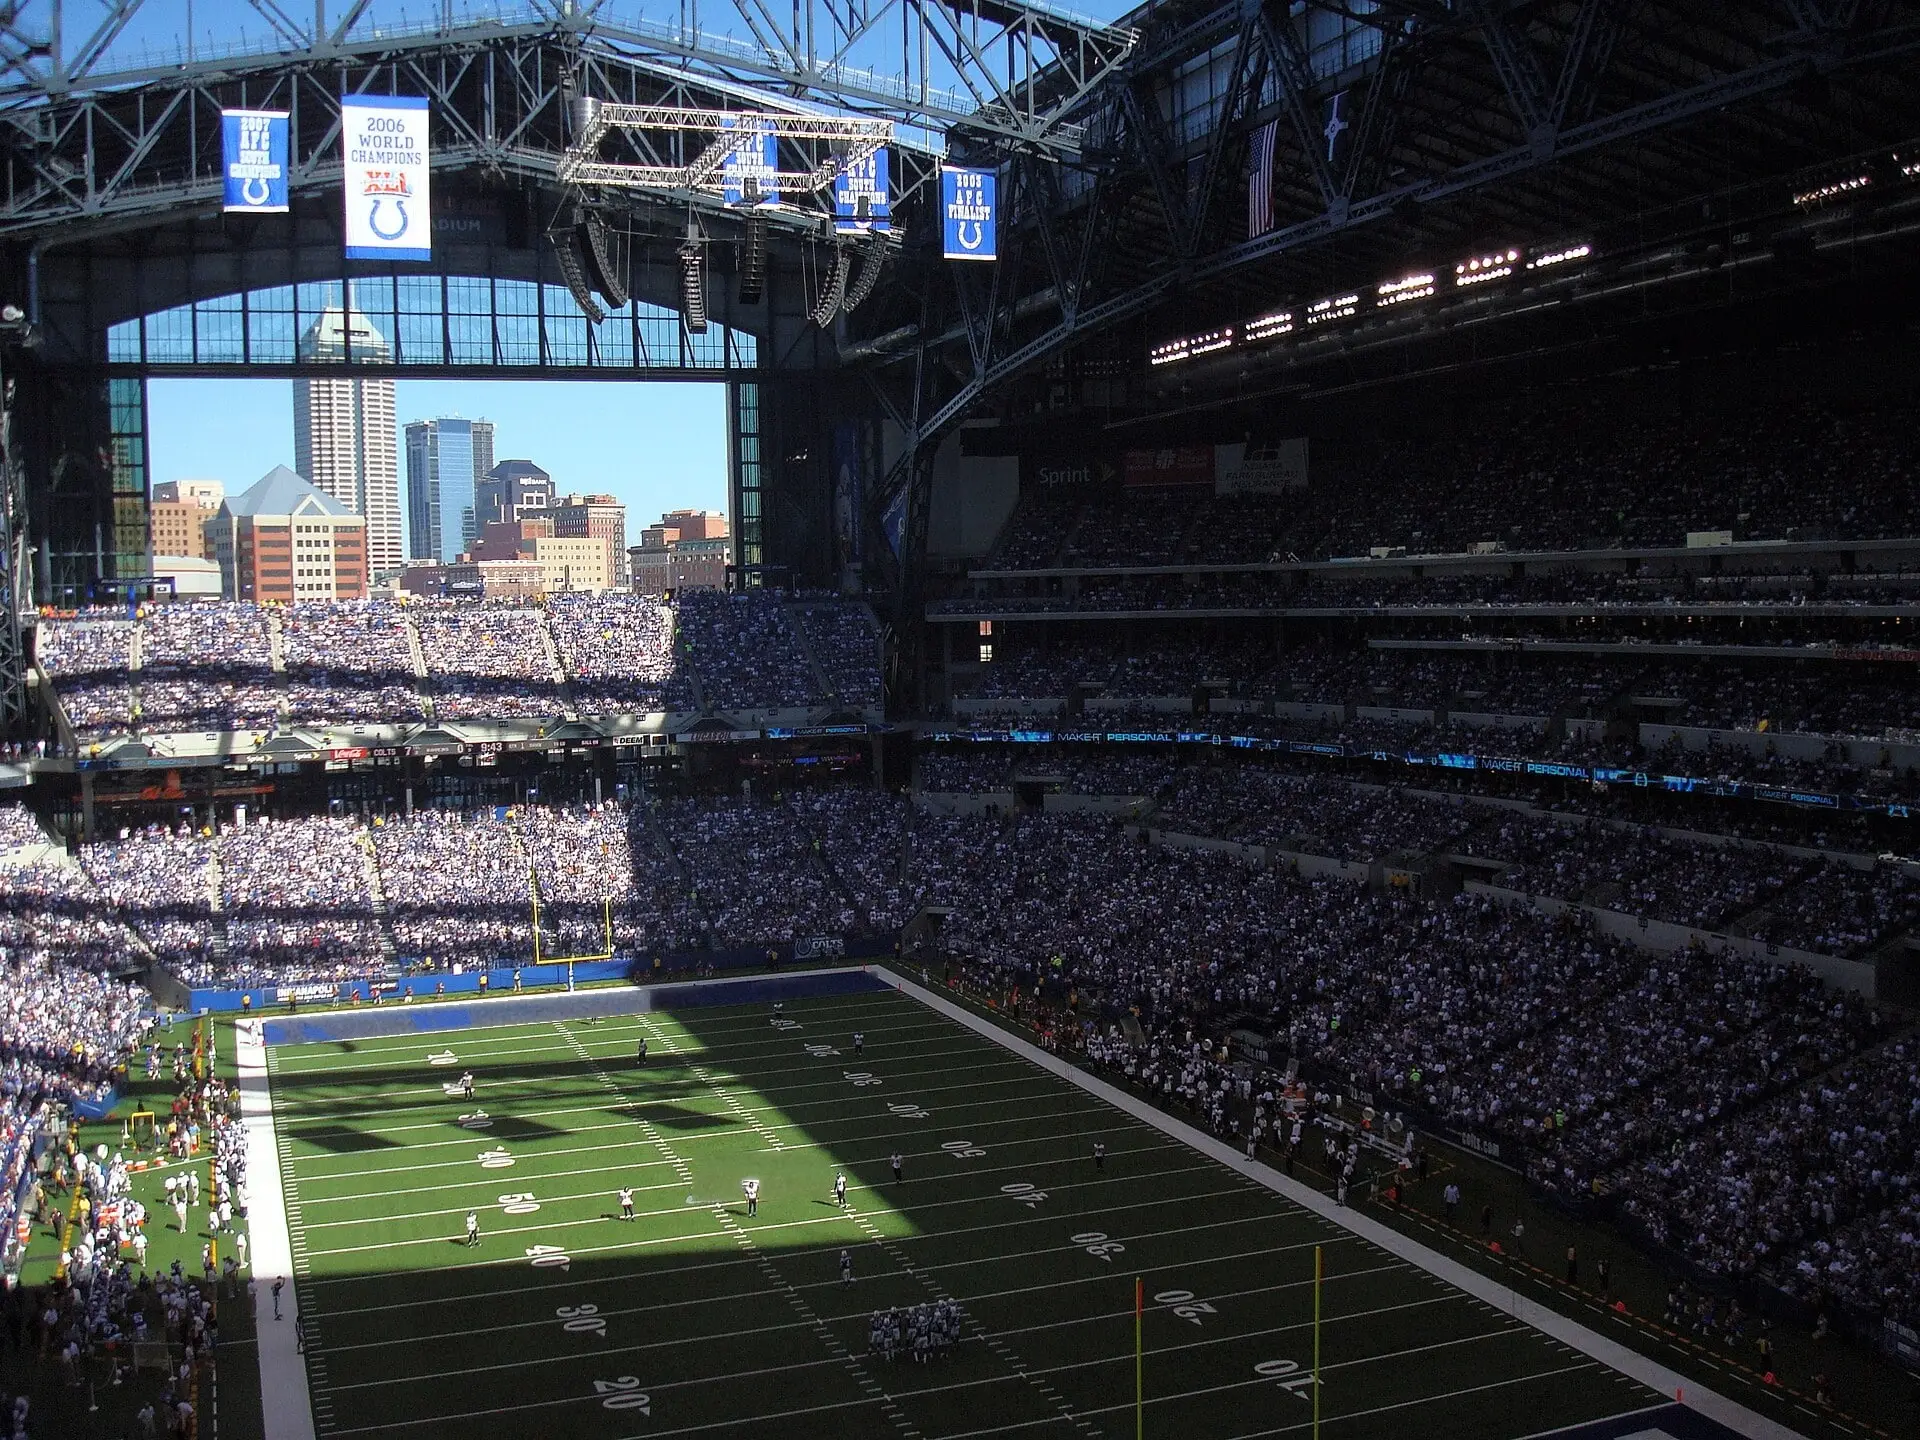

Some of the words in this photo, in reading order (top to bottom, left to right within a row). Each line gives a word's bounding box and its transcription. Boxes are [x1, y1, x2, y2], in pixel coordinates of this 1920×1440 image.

[241, 117, 271, 131] 2007
[367, 117, 405, 132] 2006
[359, 134, 414, 149] WORLD
[351, 149, 421, 164] CHAMPIONS
[848, 178, 876, 191] SOUTH
[956, 189, 983, 206] AFC
[948, 203, 991, 220] FINALIST
[1039, 466, 1091, 486] Sprint
[619, 736, 644, 745] DEEM
[1107, 733, 1172, 742] PERSONAL
[373, 748, 396, 757] COLTS
[404, 746, 411, 756] 7
[457, 744, 464, 753] 0
[480, 743, 502, 752] 9:43
[1527, 762, 1589, 778] PERSONAL
[1790, 792, 1833, 805] PERSONAL
[812, 939, 844, 950] COLTS
[804, 1044, 840, 1057] 20
[428, 1053, 459, 1065] 10
[844, 1073, 883, 1087] 30
[889, 1104, 930, 1118] 40
[940, 1140, 987, 1158] 50
[1000, 1183, 1047, 1201] 40
[498, 1192, 540, 1214] 50
[1070, 1232, 1125, 1255] 30
[525, 1245, 570, 1267] 40
[1154, 1290, 1217, 1318] 20
[556, 1304, 606, 1331] 30
[1253, 1358, 1324, 1391] 10
[593, 1375, 650, 1409] 20
